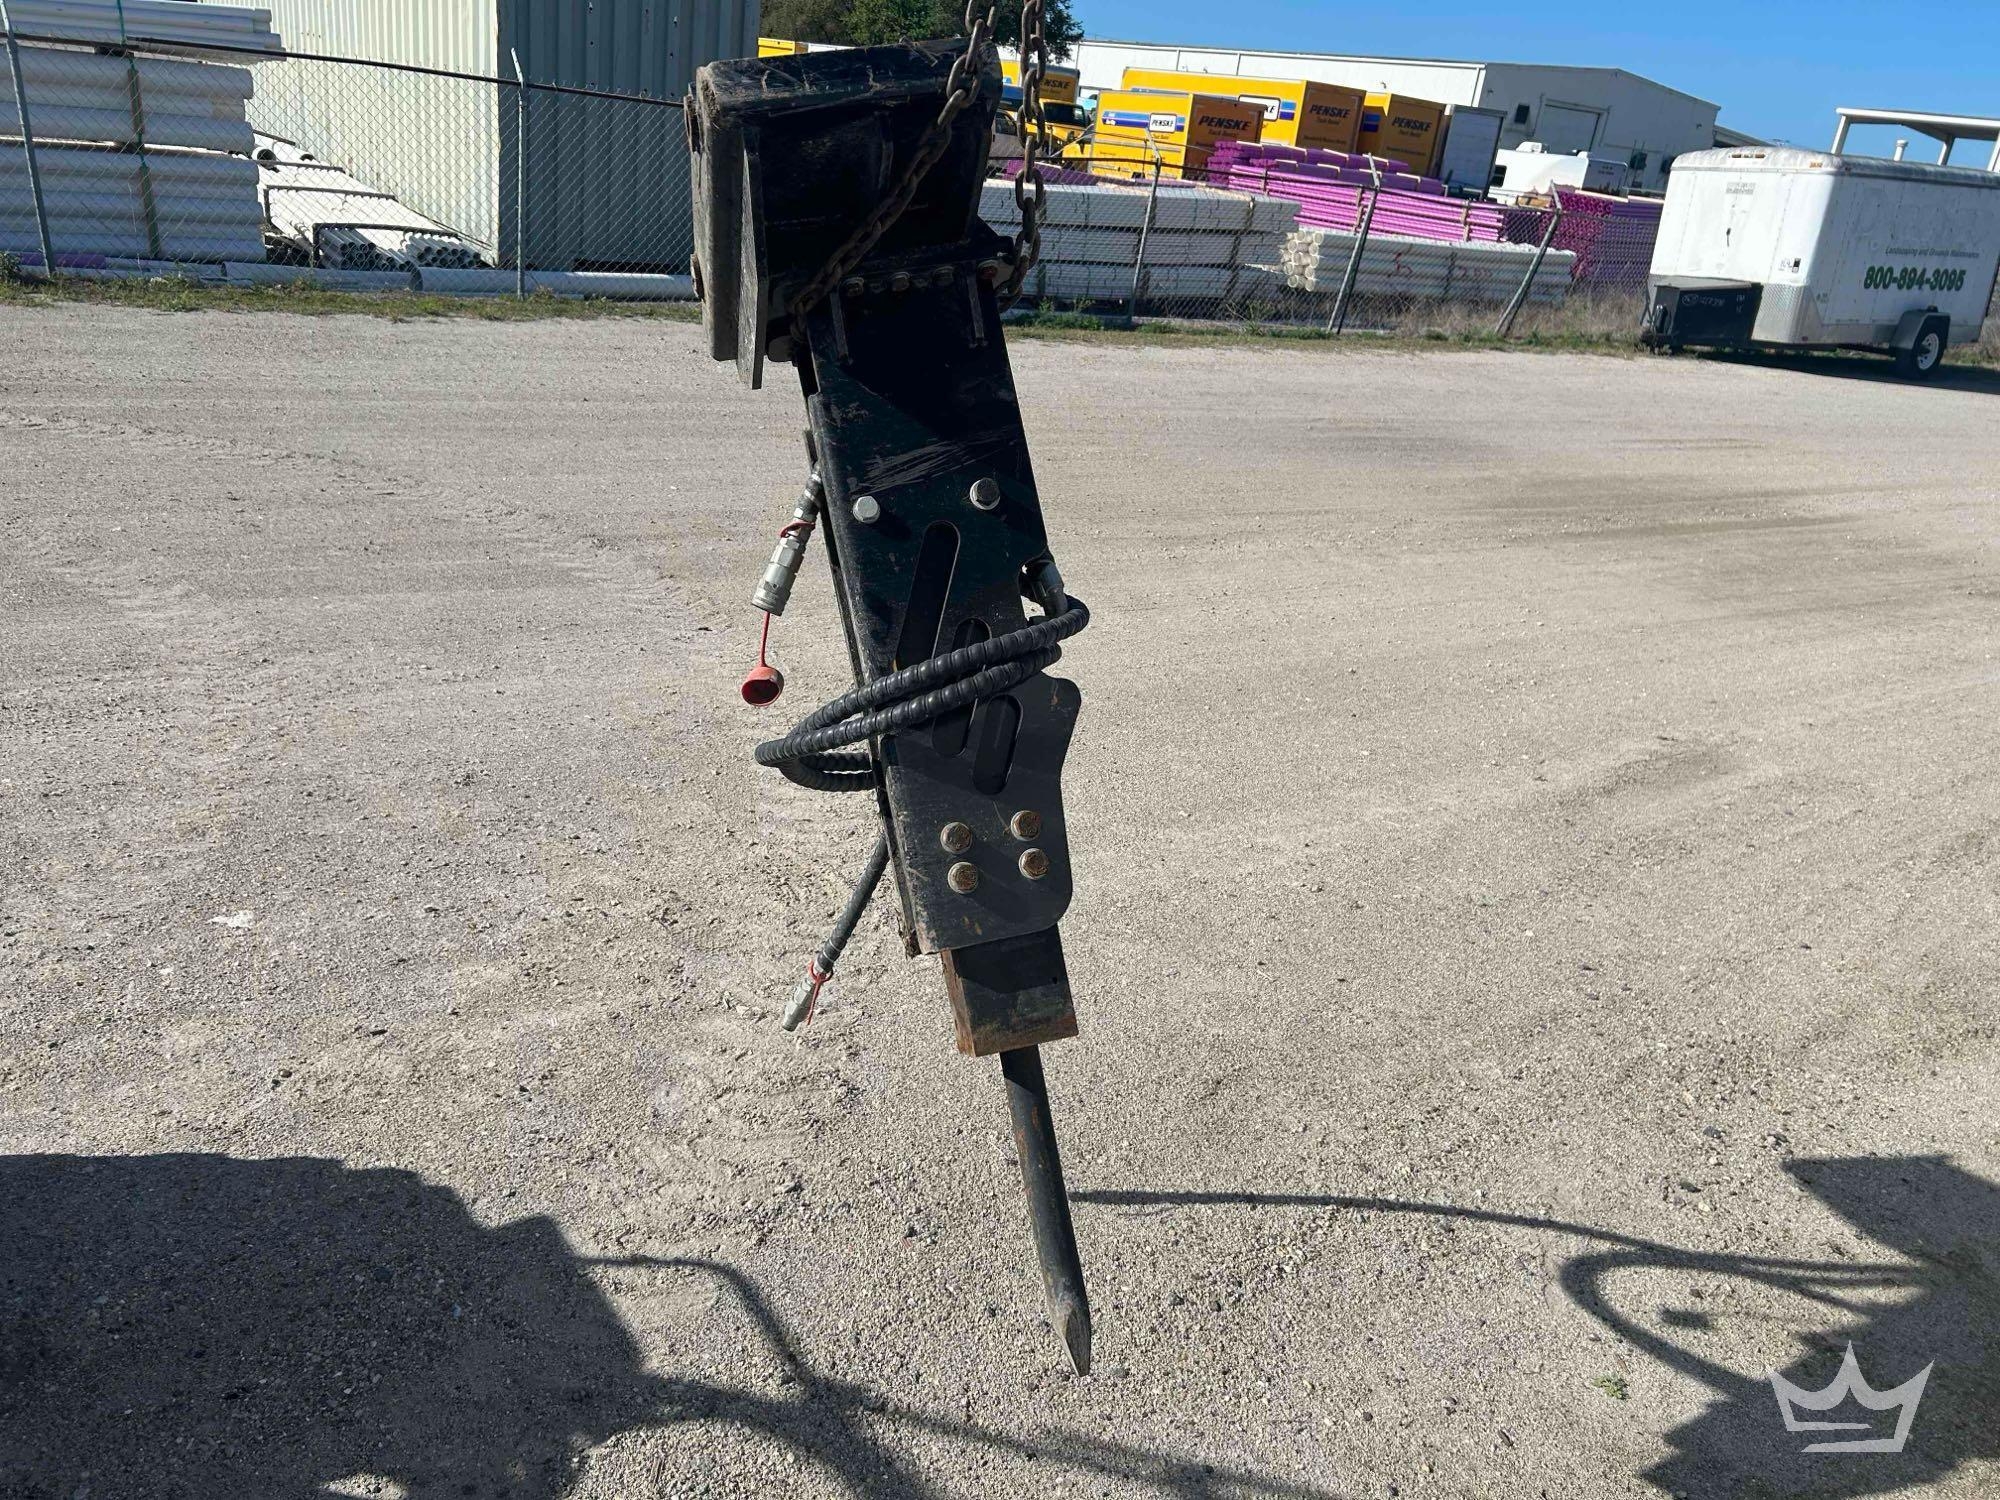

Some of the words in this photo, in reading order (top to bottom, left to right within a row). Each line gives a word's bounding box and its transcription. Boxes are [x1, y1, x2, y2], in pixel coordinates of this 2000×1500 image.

[1309, 104, 1351, 119] PENSKE
[1151, 119, 1174, 128] PENSKE
[1198, 115, 1252, 131] PENSKE
[1392, 116, 1433, 132] PENSKE
